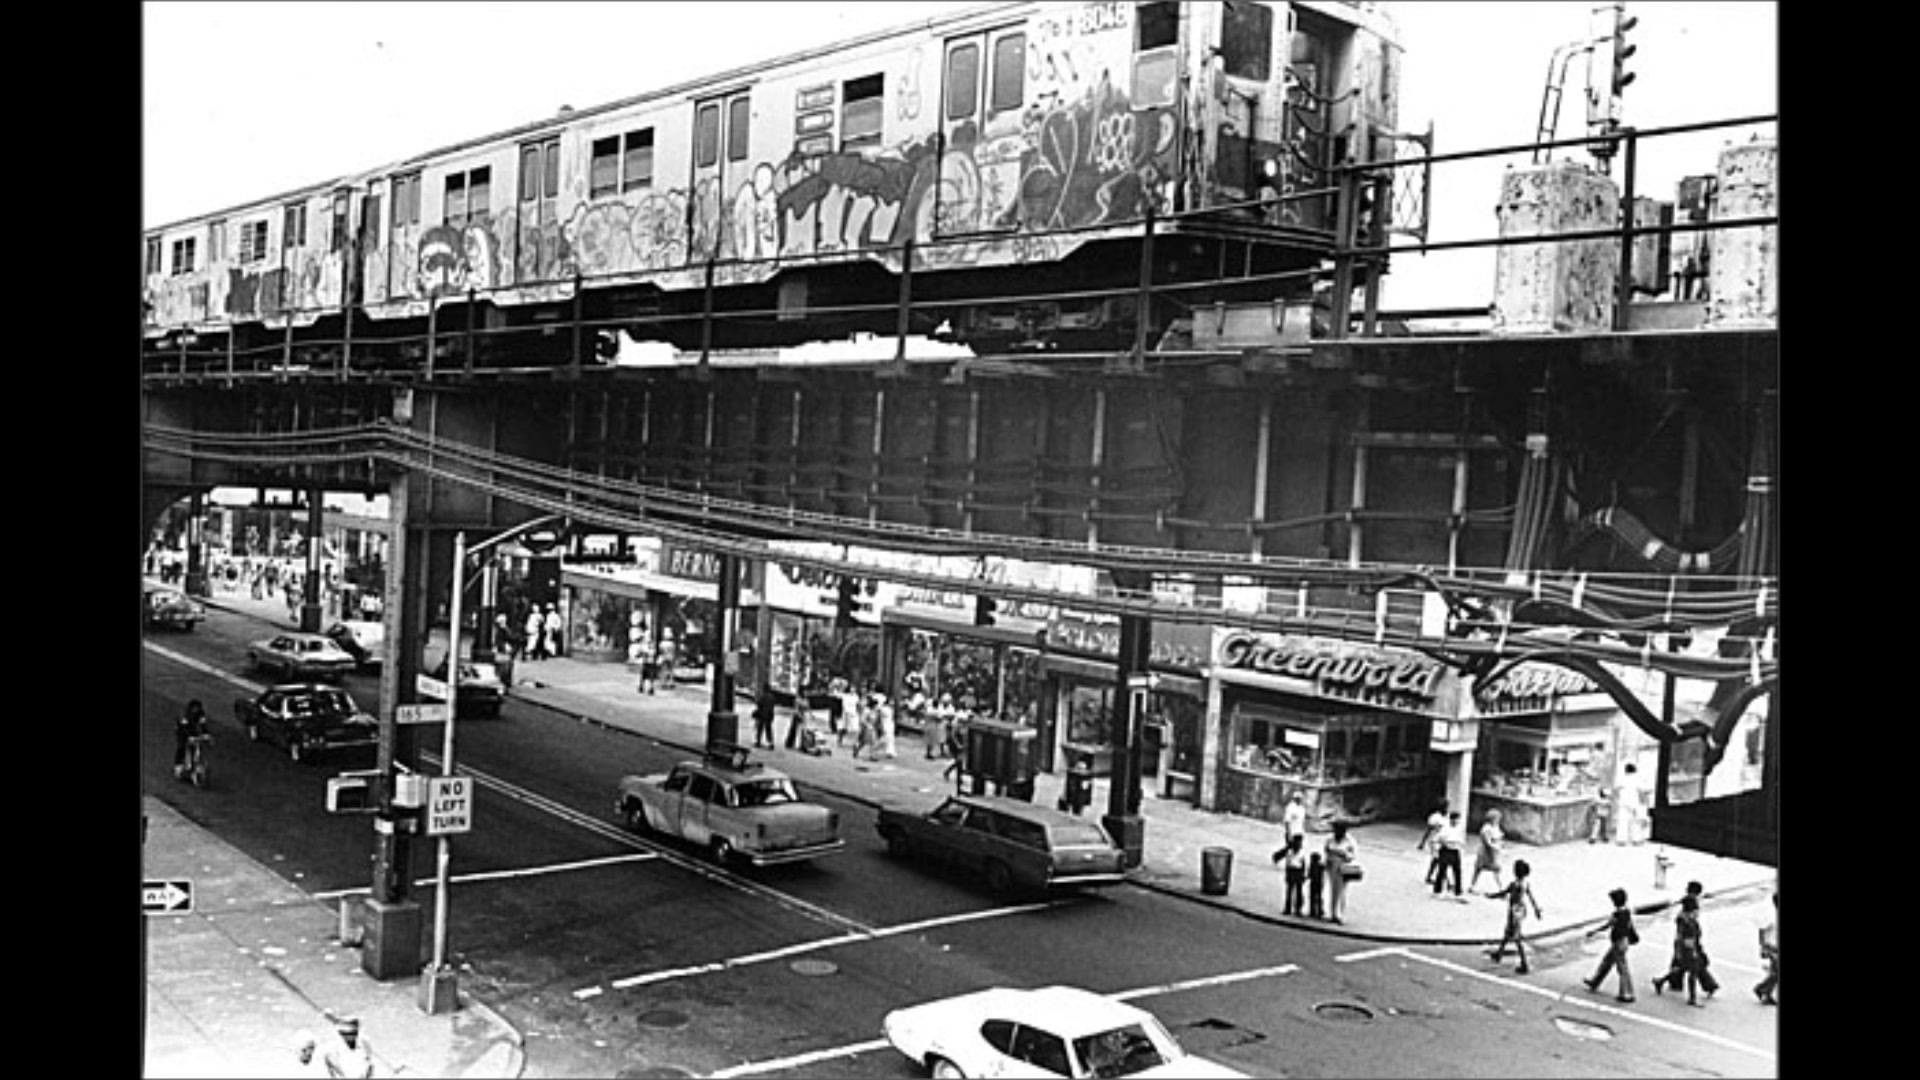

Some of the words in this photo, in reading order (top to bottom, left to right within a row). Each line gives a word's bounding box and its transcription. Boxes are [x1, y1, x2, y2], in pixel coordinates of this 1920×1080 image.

[439, 781, 464, 795] NO
[434, 798, 466, 814] LEFT
[434, 815, 466, 829] TURN
